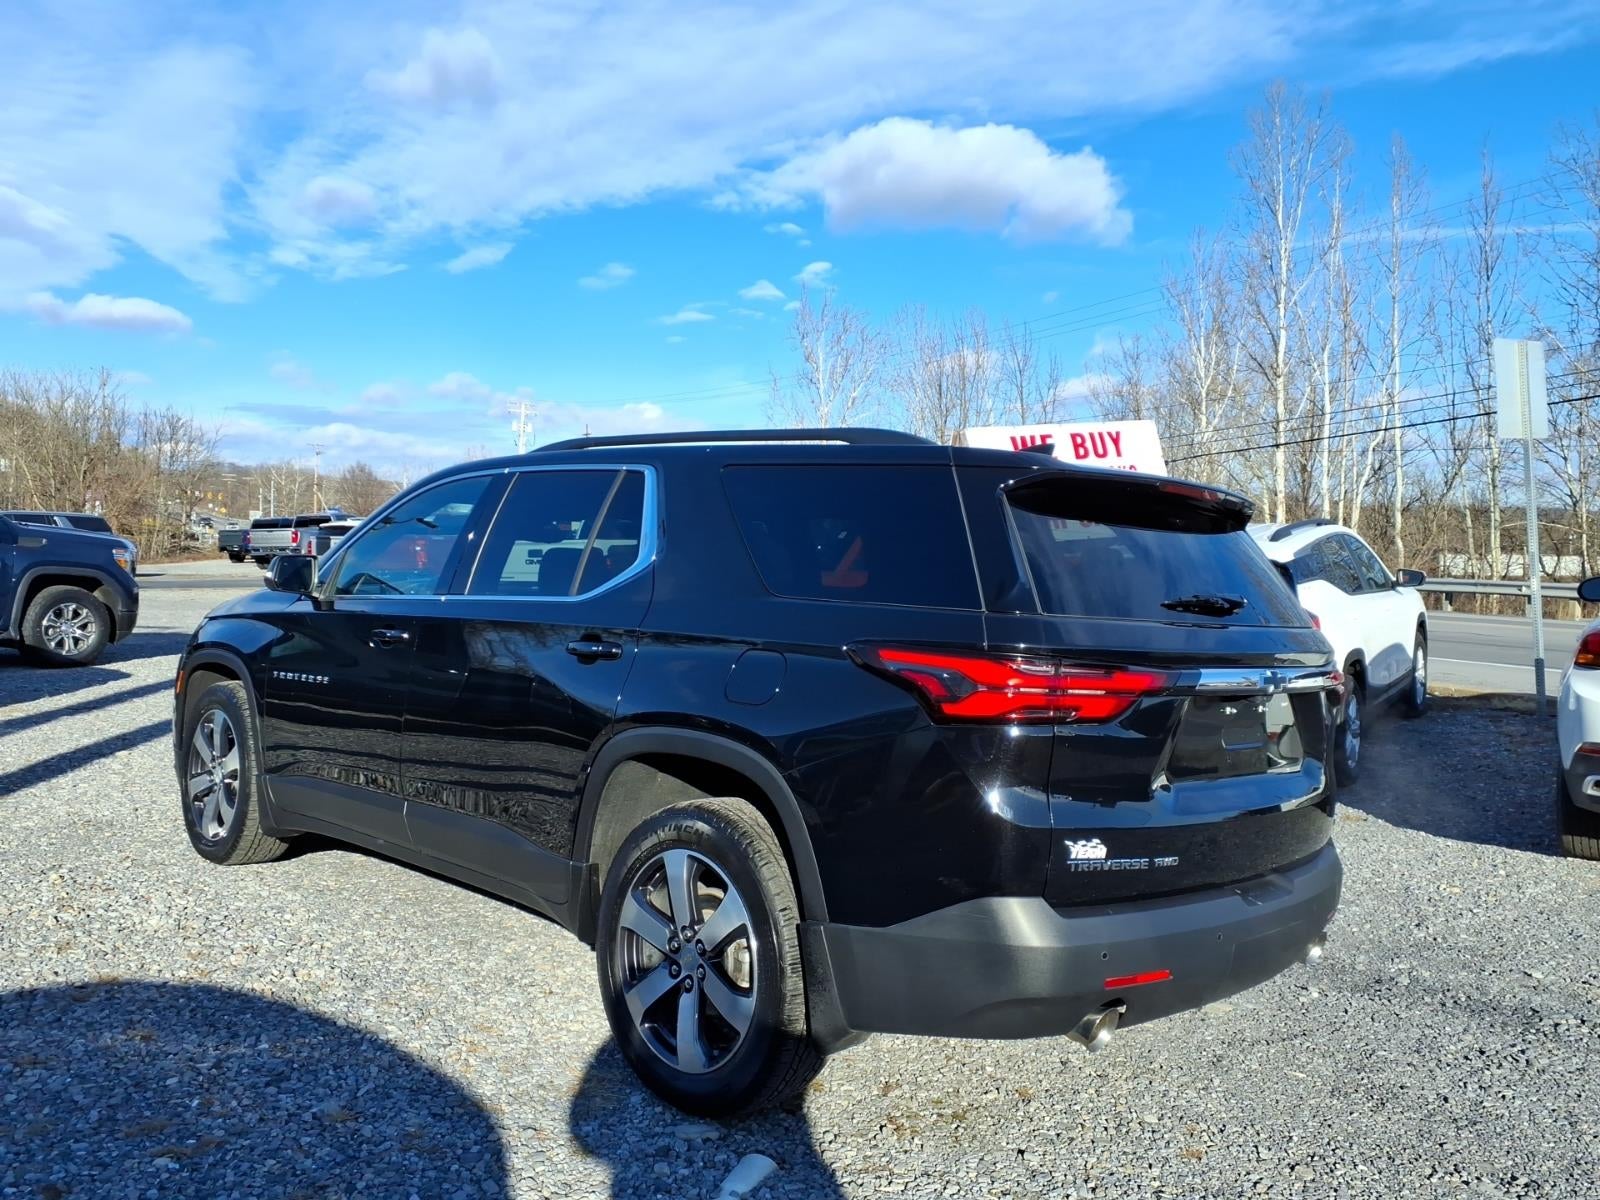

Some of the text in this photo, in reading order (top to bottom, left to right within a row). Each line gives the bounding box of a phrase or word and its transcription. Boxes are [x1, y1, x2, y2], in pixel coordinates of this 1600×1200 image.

[1070, 431, 1123, 460] BUY
[1066, 856, 1179, 872] TRAVERSE AWD
